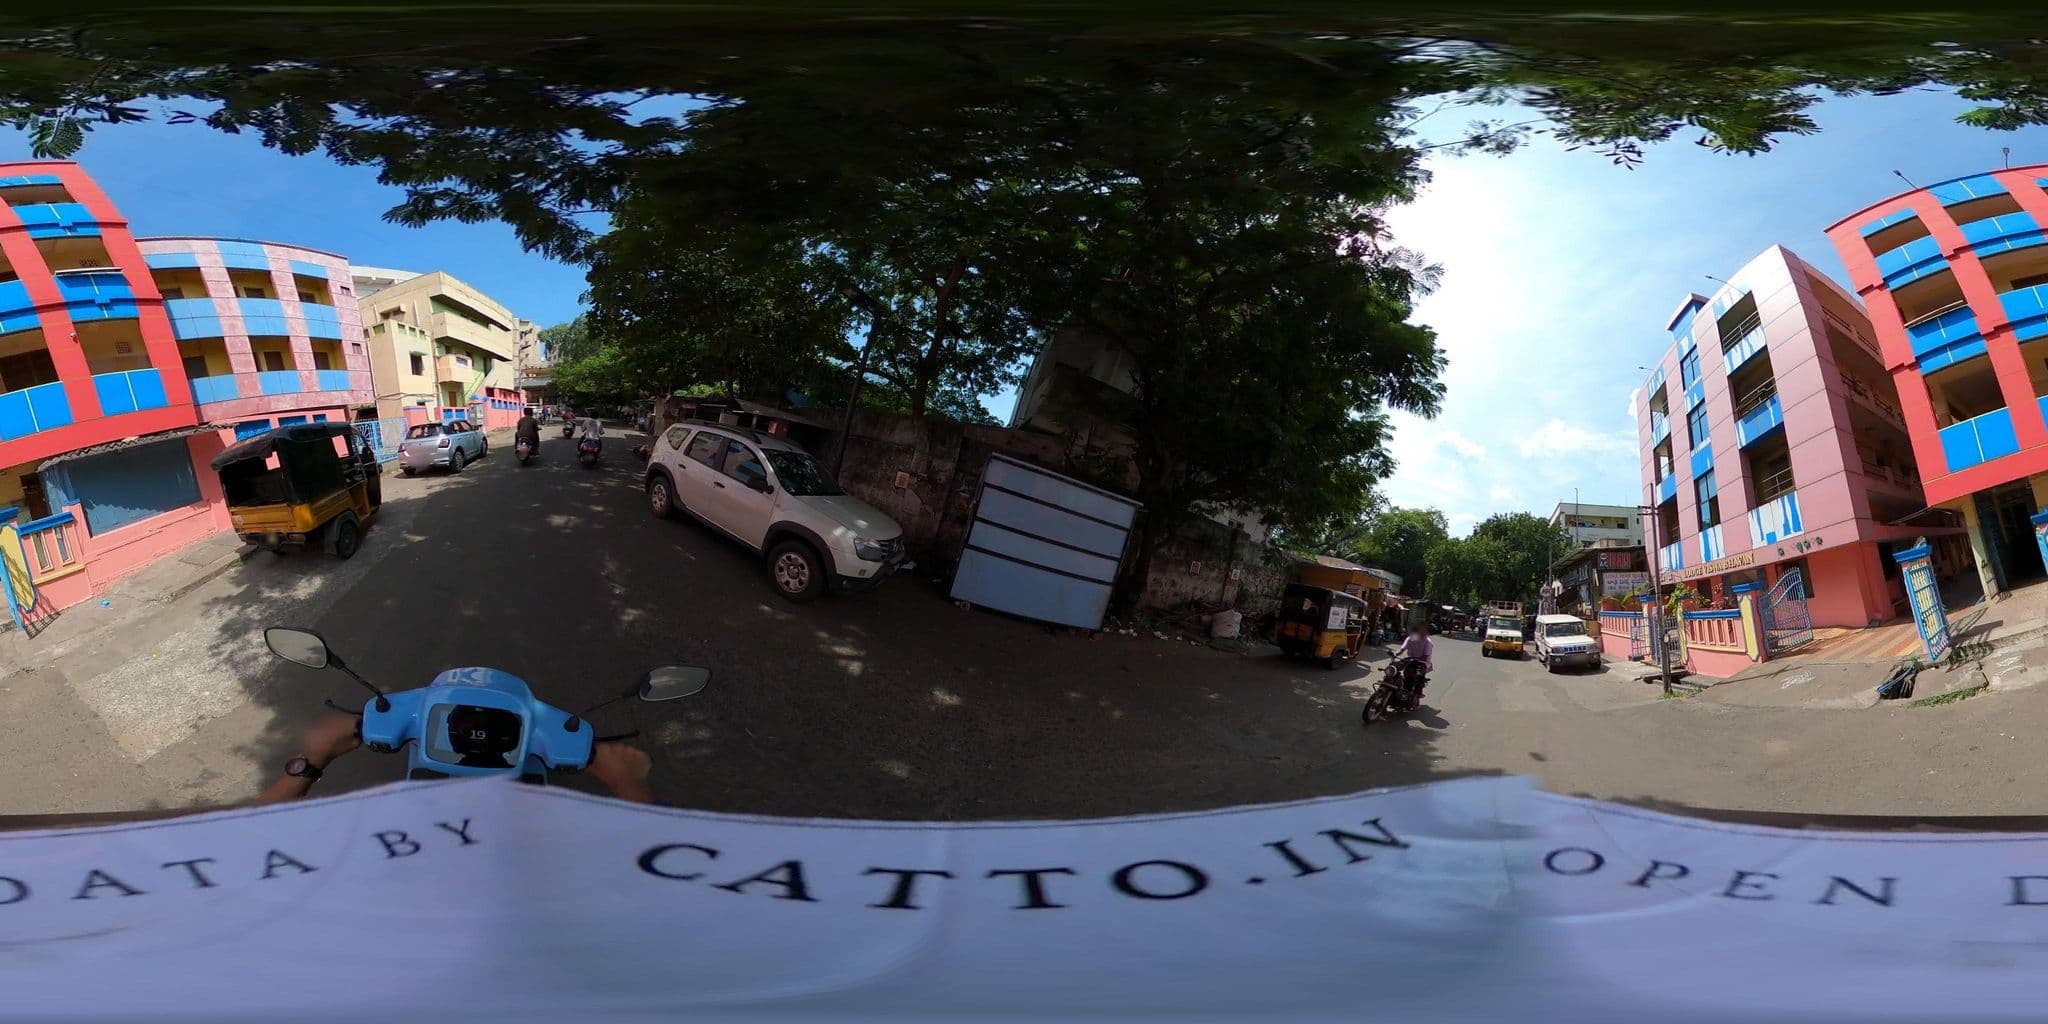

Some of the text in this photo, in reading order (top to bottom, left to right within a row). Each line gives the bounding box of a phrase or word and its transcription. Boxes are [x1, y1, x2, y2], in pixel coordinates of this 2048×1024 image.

[470, 729, 487, 740] 19
[371, 818, 478, 860] BY
[636, 817, 1411, 911] CATTO.IN
[1542, 847, 1897, 908] OPEN
